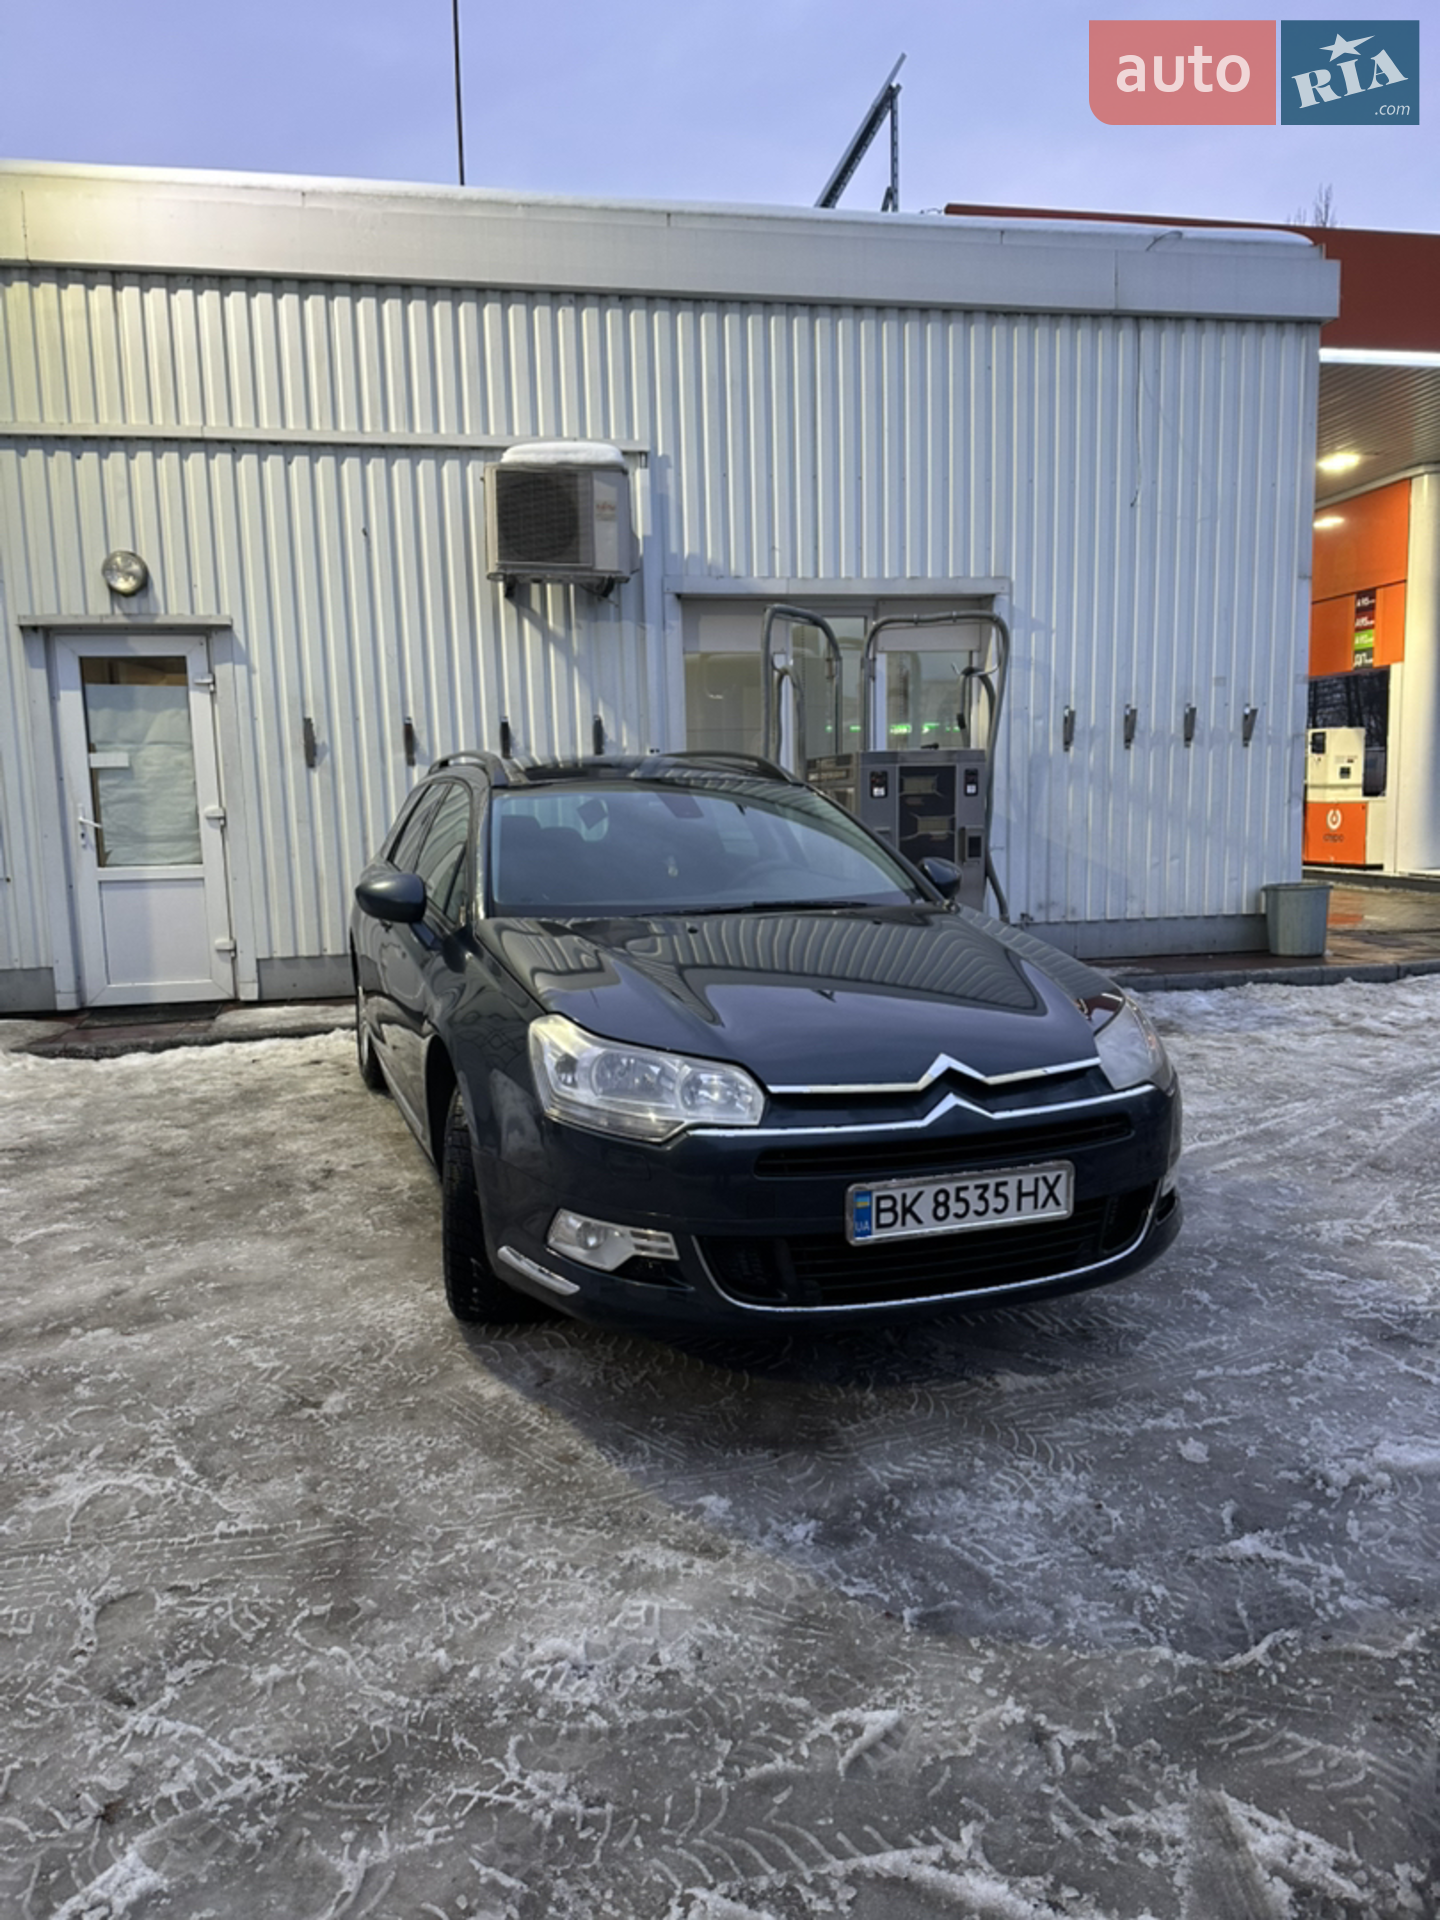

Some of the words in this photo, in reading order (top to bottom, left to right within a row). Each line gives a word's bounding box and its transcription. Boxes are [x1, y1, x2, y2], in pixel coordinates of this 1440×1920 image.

[874, 1190, 925, 1230] BK
[932, 1180, 1010, 1222] 8535
[1016, 1173, 1063, 1212] HX
[854, 1220, 870, 1232] UA
